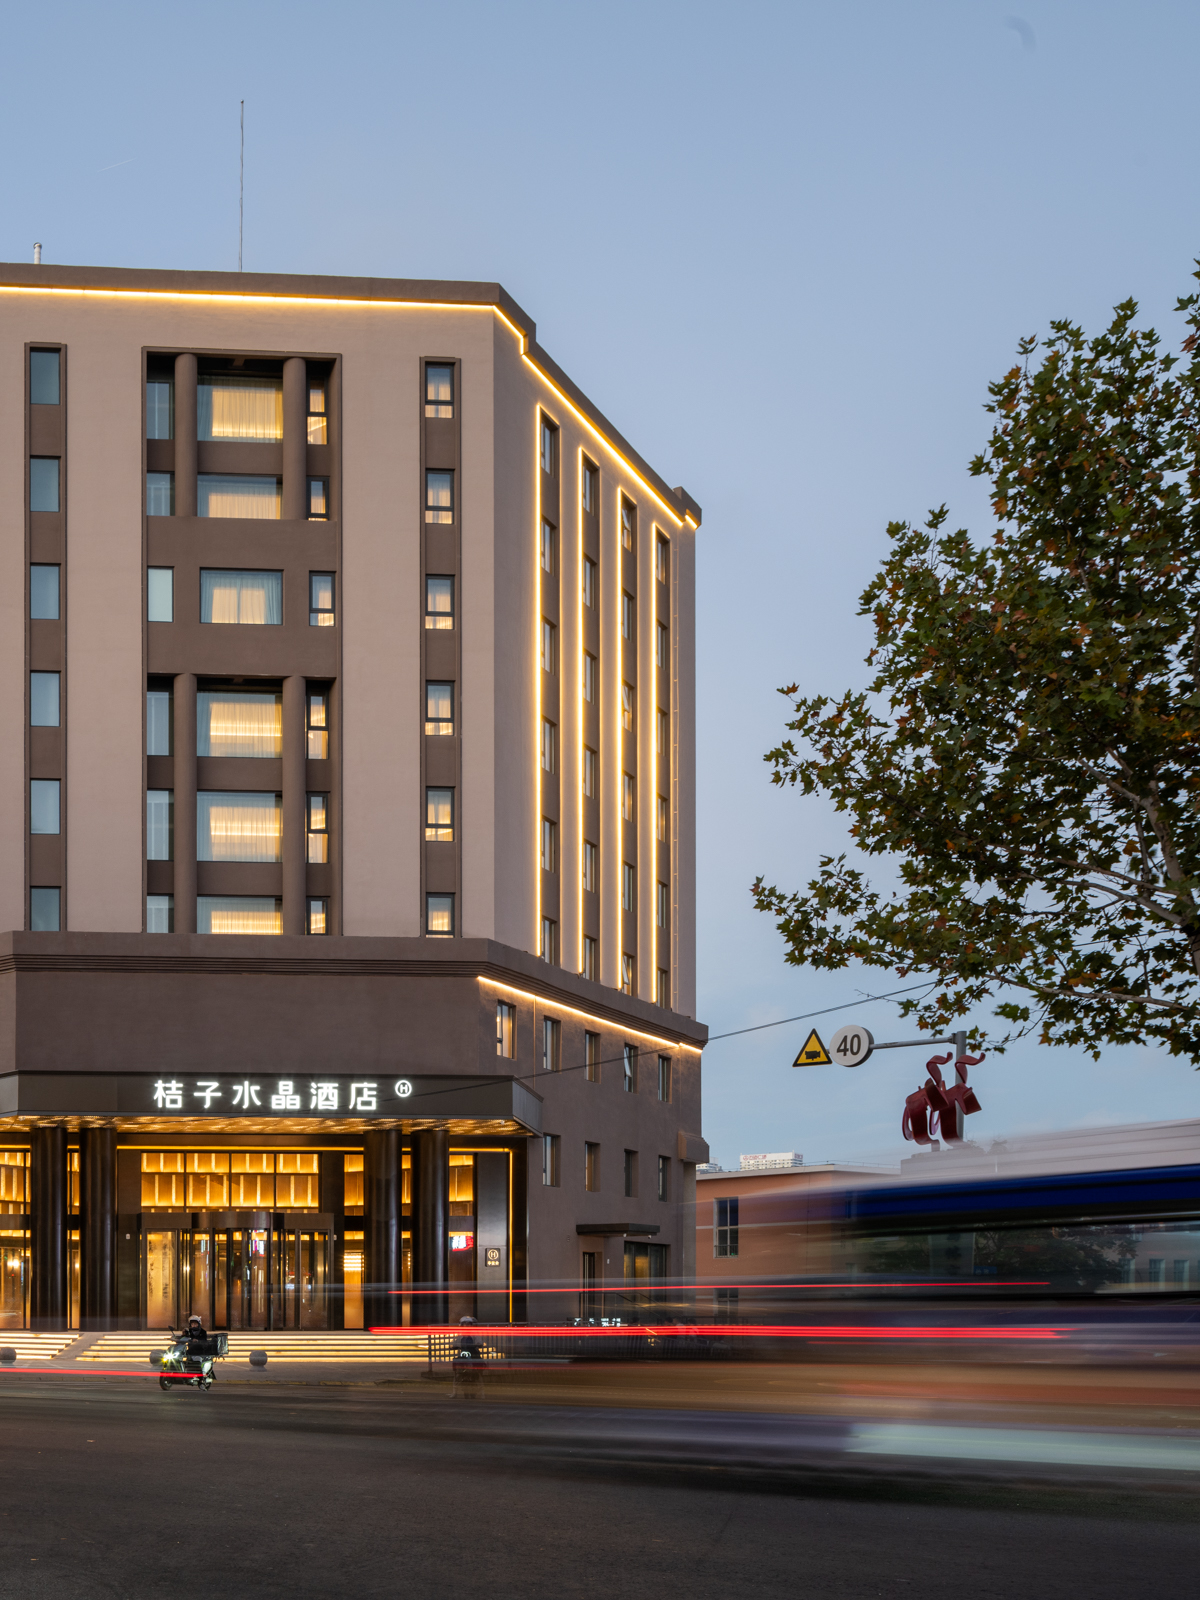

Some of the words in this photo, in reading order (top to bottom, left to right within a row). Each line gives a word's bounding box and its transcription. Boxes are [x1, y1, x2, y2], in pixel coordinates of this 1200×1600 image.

[836, 1033, 862, 1057] 40
[153, 1080, 378, 1110] 桔子水晶酒店
